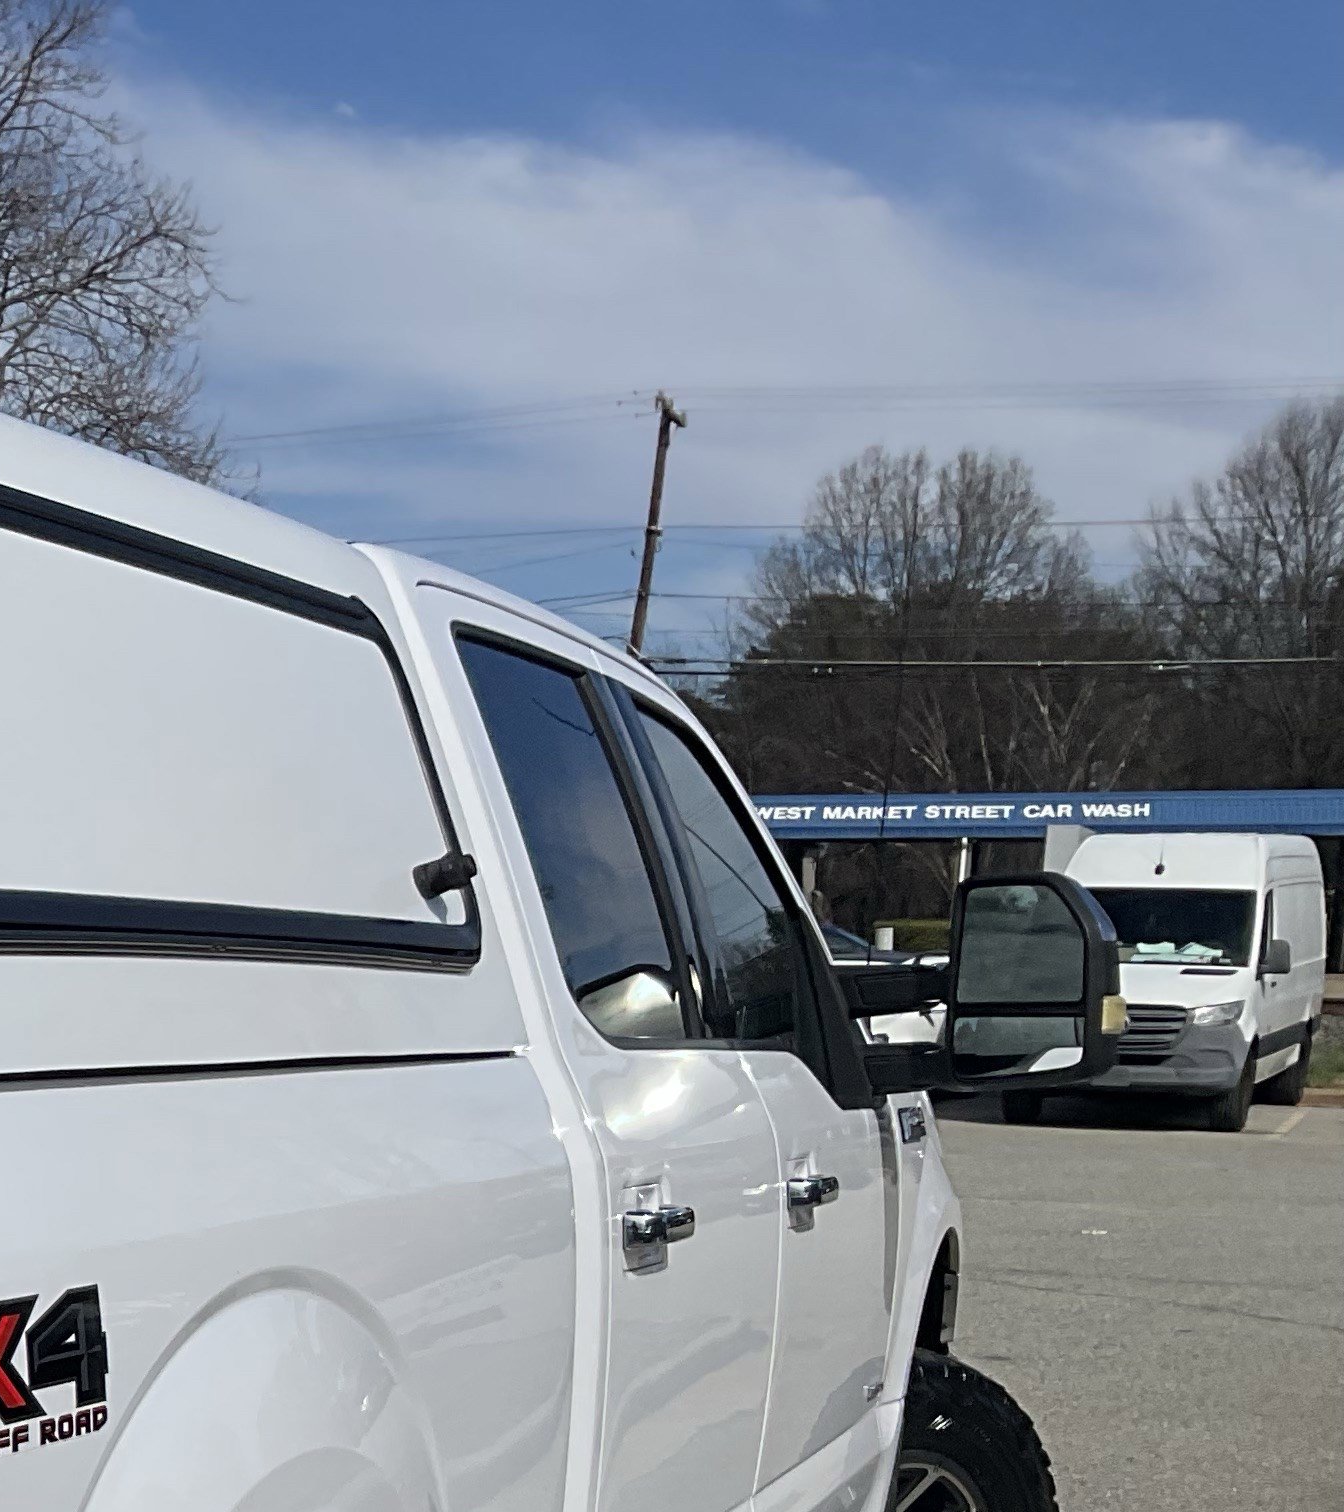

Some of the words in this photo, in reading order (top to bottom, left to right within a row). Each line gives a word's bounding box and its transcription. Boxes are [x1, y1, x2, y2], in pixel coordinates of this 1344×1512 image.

[755, 805, 816, 820] WEST
[822, 805, 918, 820] MARKET
[924, 804, 1015, 820] STREET
[1023, 804, 1073, 818] CAR
[1081, 803, 1151, 818] WASH
[39, 1405, 109, 1446] ROAD
